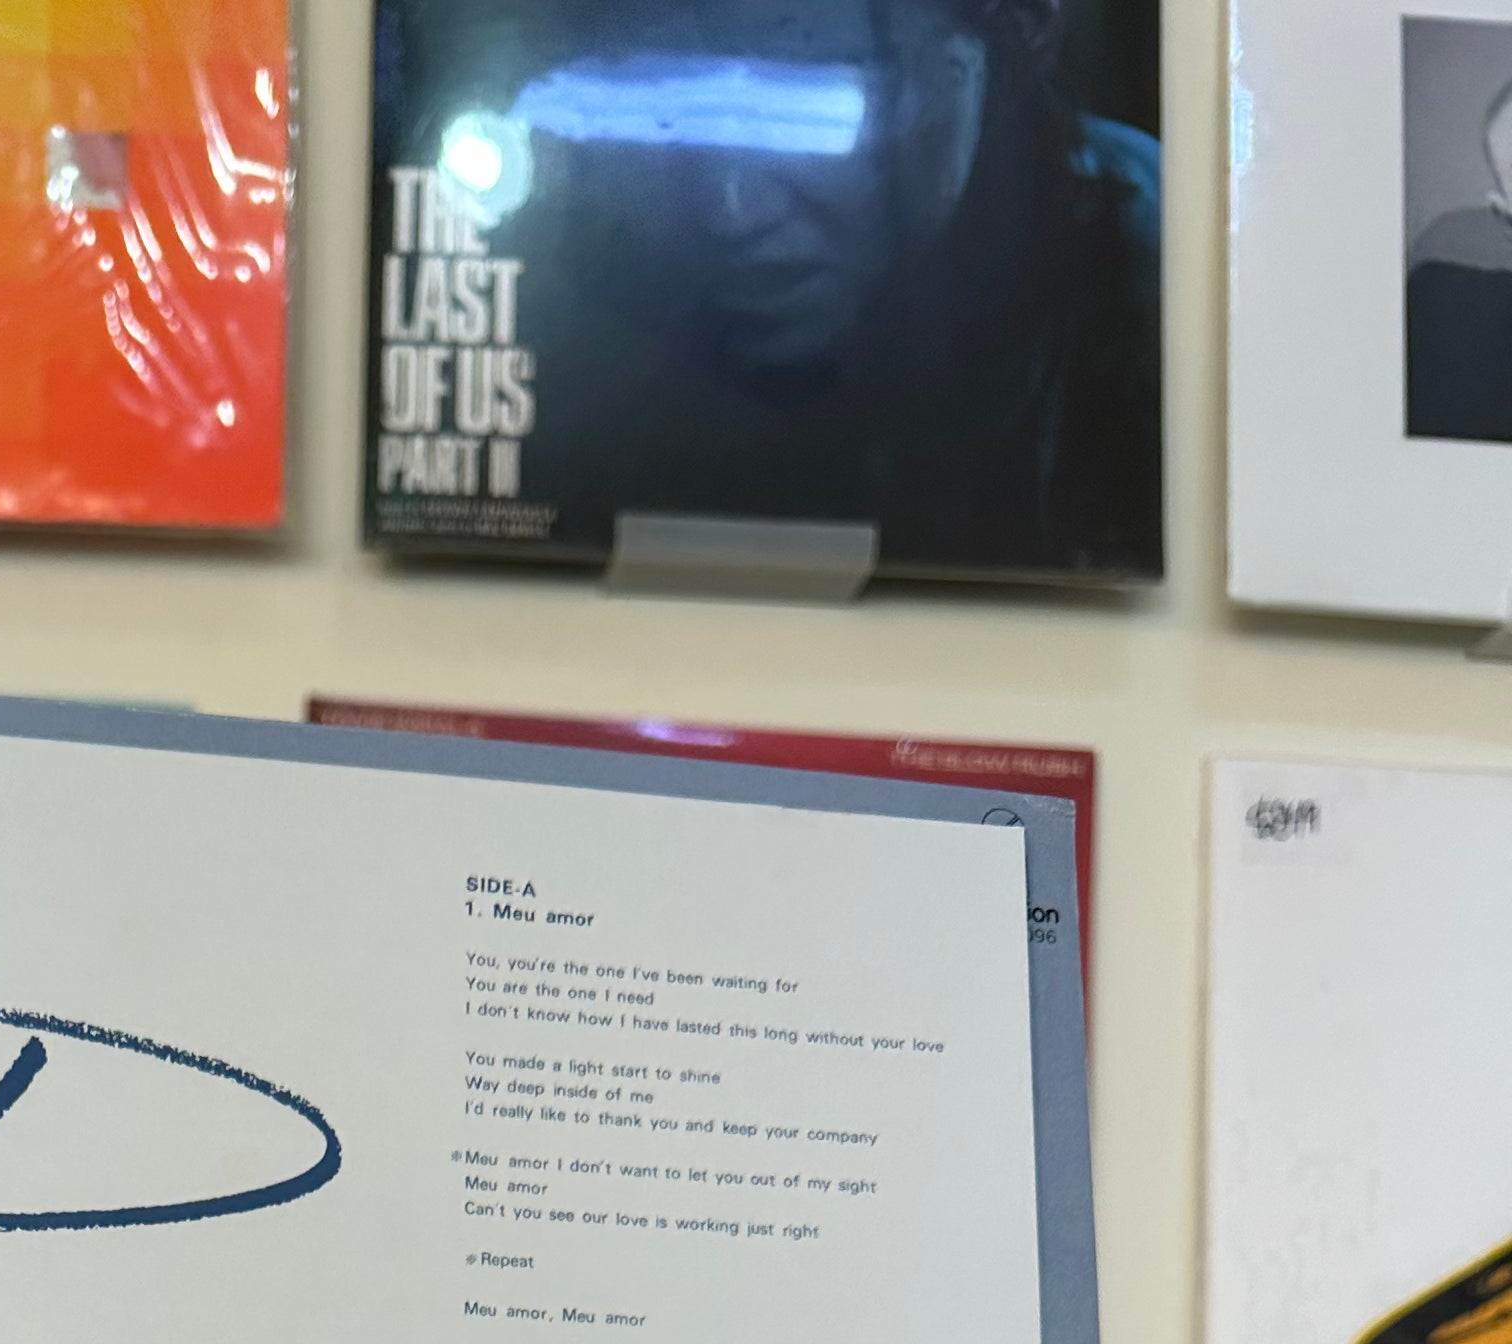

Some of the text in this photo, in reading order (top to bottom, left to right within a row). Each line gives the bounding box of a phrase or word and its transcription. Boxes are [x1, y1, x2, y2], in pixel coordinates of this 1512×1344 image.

[381, 253, 525, 343] LAST
[380, 343, 536, 437] OF US
[376, 434, 481, 496] PART
[466, 875, 536, 898] SIDE-A
[493, 901, 536, 923] Meu
[545, 910, 594, 927] amor
[563, 960, 589, 976] the
[596, 964, 627, 979] one
[666, 968, 704, 985] been
[712, 975, 769, 994] waiting
[776, 978, 799, 993] for
